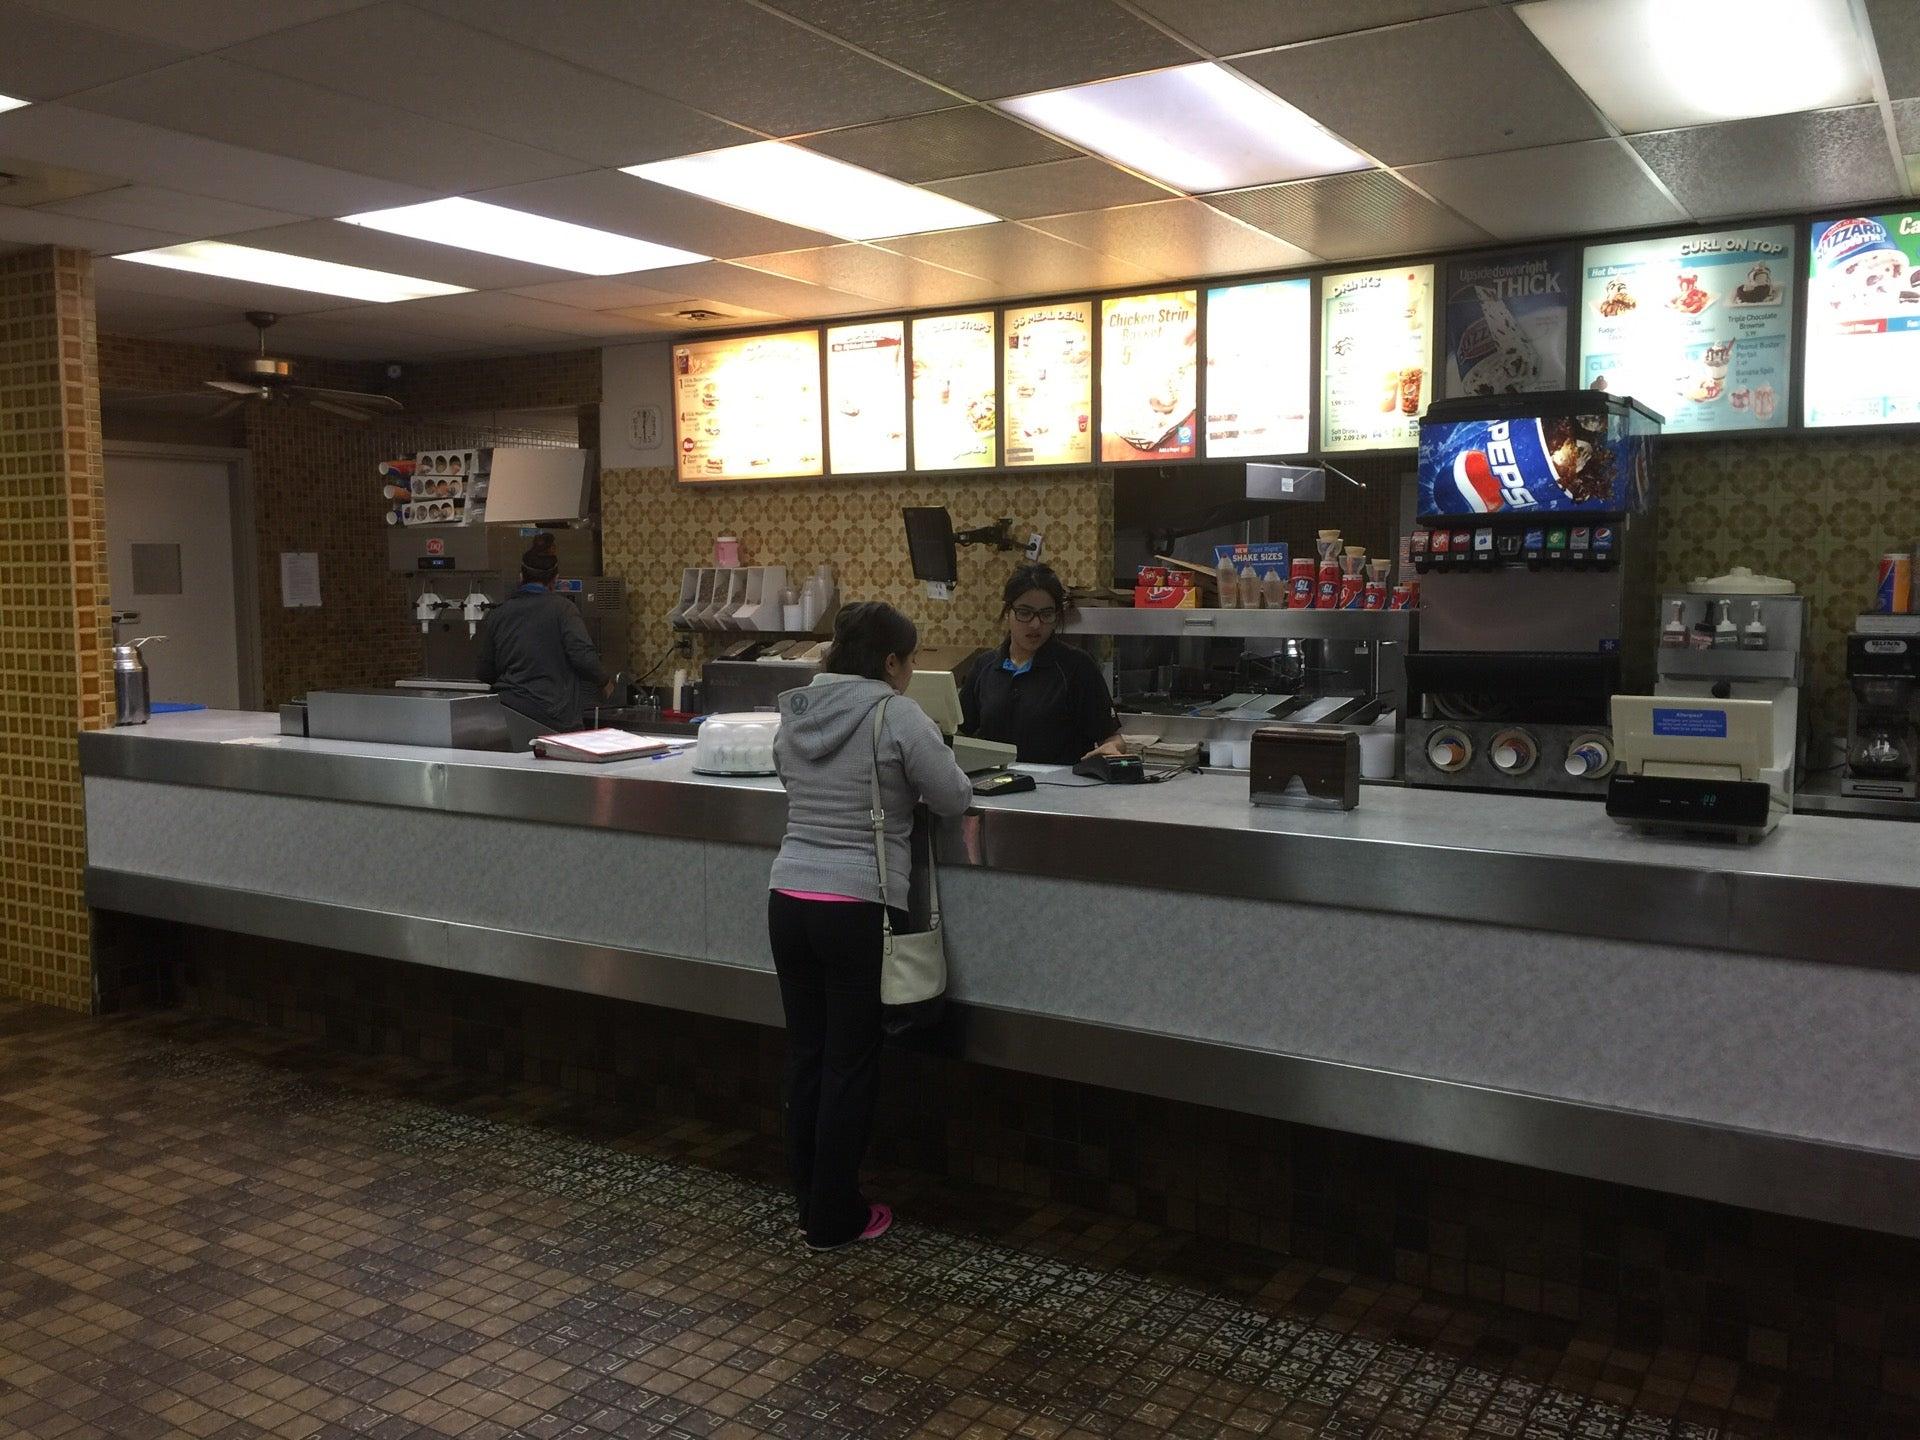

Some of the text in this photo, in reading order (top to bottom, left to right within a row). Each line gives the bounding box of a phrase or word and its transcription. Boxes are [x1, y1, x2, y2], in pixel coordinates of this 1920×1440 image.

[1681, 238, 1784, 256] CURL ON TOP
[1494, 272, 1562, 304] THICK
[1109, 305, 1190, 328] Chicken Strip
[1747, 313, 1778, 322] Chocolate
[1739, 322, 1766, 330] Brownie
[1232, 552, 1283, 562] SHAKE SIZES
